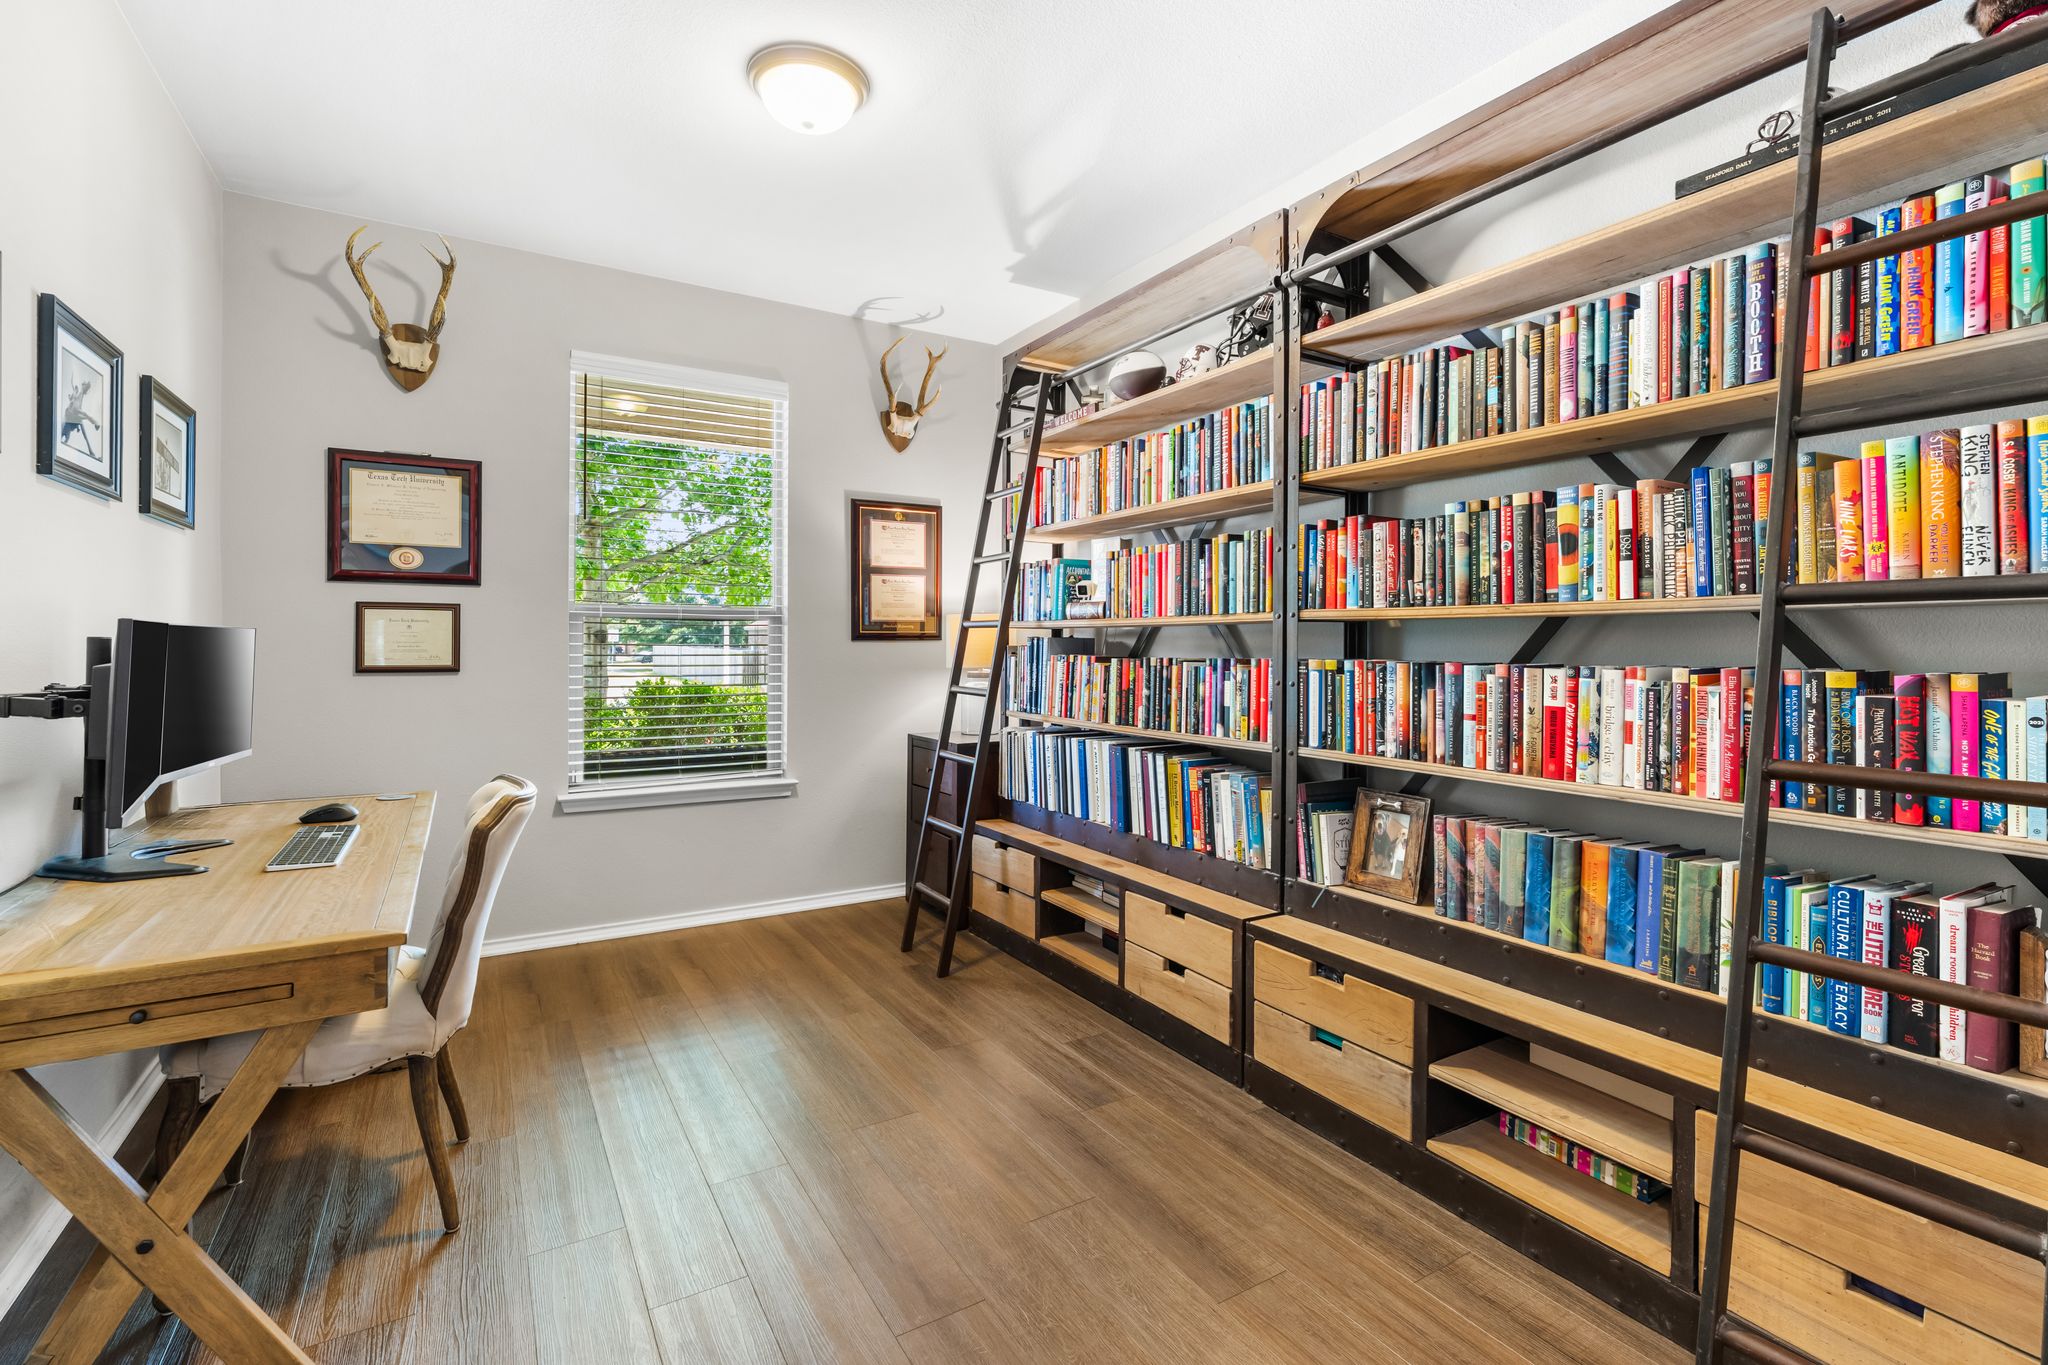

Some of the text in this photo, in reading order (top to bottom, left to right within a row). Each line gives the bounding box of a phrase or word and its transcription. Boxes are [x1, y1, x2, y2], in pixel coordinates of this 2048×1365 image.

[1846, 119, 1863, 129] JUNE
[1735, 159, 1752, 170] DAILY
[2020, 220, 2033, 264] SHARK HEART
[1879, 275, 1894, 341] HANK GREEN
[1905, 267, 1924, 336] HANK GREEN
[1749, 283, 1763, 373] BOOTH
[1529, 333, 1542, 355] JAMES
[1560, 347, 1575, 394] BOMBSHELL
[1530, 387, 1539, 414] EVERETT
[1054, 406, 1088, 427] WELCOME
[1962, 434, 1980, 478] KING
[1979, 433, 1992, 476] STEPHEN
[367, 471, 445, 486] Texas Tech University
[1759, 476, 1769, 489] THE
[1892, 453, 1908, 513] ANTIDOTE
[1929, 435, 1946, 521] STEPHEN KING
[2002, 458, 2017, 485] COSBY
[1712, 478, 1720, 495] Tom
[1735, 491, 1748, 499] YOU
[1712, 496, 1721, 512] Lake
[1759, 490, 1769, 521] VERIFIERS
[2003, 488, 2018, 513] KING
[1597, 512, 1604, 521] NG
[1733, 513, 1752, 521] ABOUT
[1839, 500, 1858, 558] NINE LIARS
[1939, 522, 1950, 538] YOU
[2004, 524, 2018, 555] ASHES
[1619, 534, 1632, 557] 1984
[1902, 532, 1911, 560] KAREN
[1928, 523, 1940, 564] DARKER
[1940, 539, 1950, 556] LIKE
[1975, 525, 1992, 567] NEVER
[1517, 563, 1525, 588] WOODS
[1714, 550, 1722, 577] Patchett
[1512, 667, 1520, 685] ONLY
[1675, 683, 1683, 701] ONLY
[1727, 676, 1737, 730] Elin Hilderbrand
[1840, 690, 1852, 708] BURY
[1512, 694, 1520, 717] YOU'RE
[1566, 701, 1576, 728] CRYING
[1791, 689, 1799, 736] BLACK WOODS
[1807, 708, 1816, 722] The
[1512, 718, 1520, 740] LUCKY
[1602, 705, 1616, 736] bridge
[1675, 711, 1683, 735] YOU'RE
[1696, 689, 1707, 773] CHUCK PALAHNIUK
[1840, 710, 1852, 729] OUR
[1870, 705, 1886, 747] PHANTASMA
[1898, 696, 1921, 764] HOT WAX
[1566, 737, 1575, 746] H
[1636, 724, 1644, 748] beatriz
[1724, 732, 1735, 750] The
[1807, 723, 1817, 752] Anxious
[1830, 733, 1842, 753] SOIL
[1931, 716, 1942, 751] McMahon
[1983, 709, 2003, 762] ONE OF THE
[1529, 736, 1538, 762] FOURTH
[1565, 746, 1574, 769] MART
[1601, 745, 1615, 767] clay
[1675, 736, 1683, 758] LUCKY
[1961, 740, 1969, 754] NOT
[1722, 750, 1734, 784] Academy
[1961, 763, 1969, 776] HAP
[1767, 899, 1778, 941] BIBLIOP
[1865, 920, 1884, 931] THE
[1970, 946, 1996, 957] Harvard
[1974, 953, 1991, 962] Book
[1977, 942, 1990, 950] The
[1834, 890, 1850, 1030] CULTURAL ERACY
[1911, 946, 1931, 1017] Great ror
[1949, 924, 1961, 1041] dream rooms hildren
[1863, 1009, 1883, 1018] BOOK
